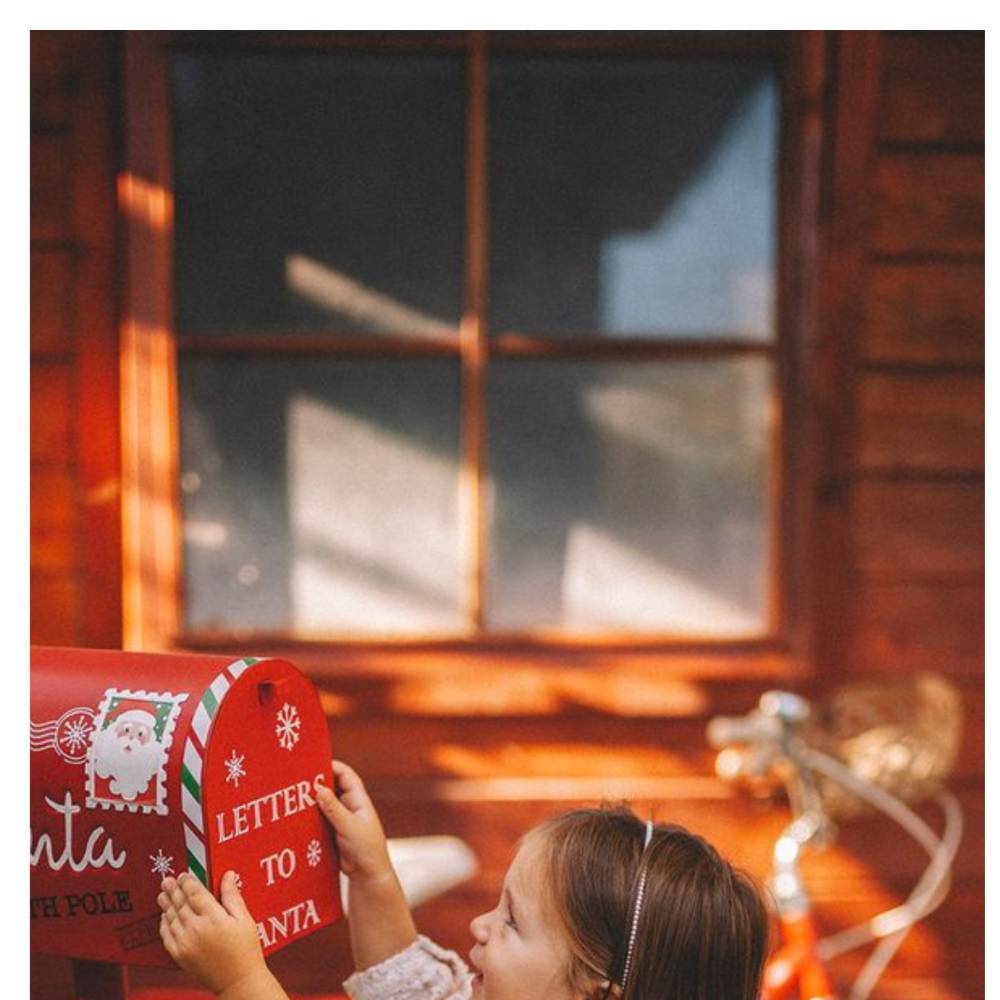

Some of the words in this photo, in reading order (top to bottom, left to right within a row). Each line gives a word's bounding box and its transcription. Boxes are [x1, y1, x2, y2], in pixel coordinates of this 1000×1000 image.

[216, 773, 326, 844] LETTERS
[260, 848, 297, 886] TO
[64, 890, 133, 916] POLE
[256, 899, 321, 948] ANTA
